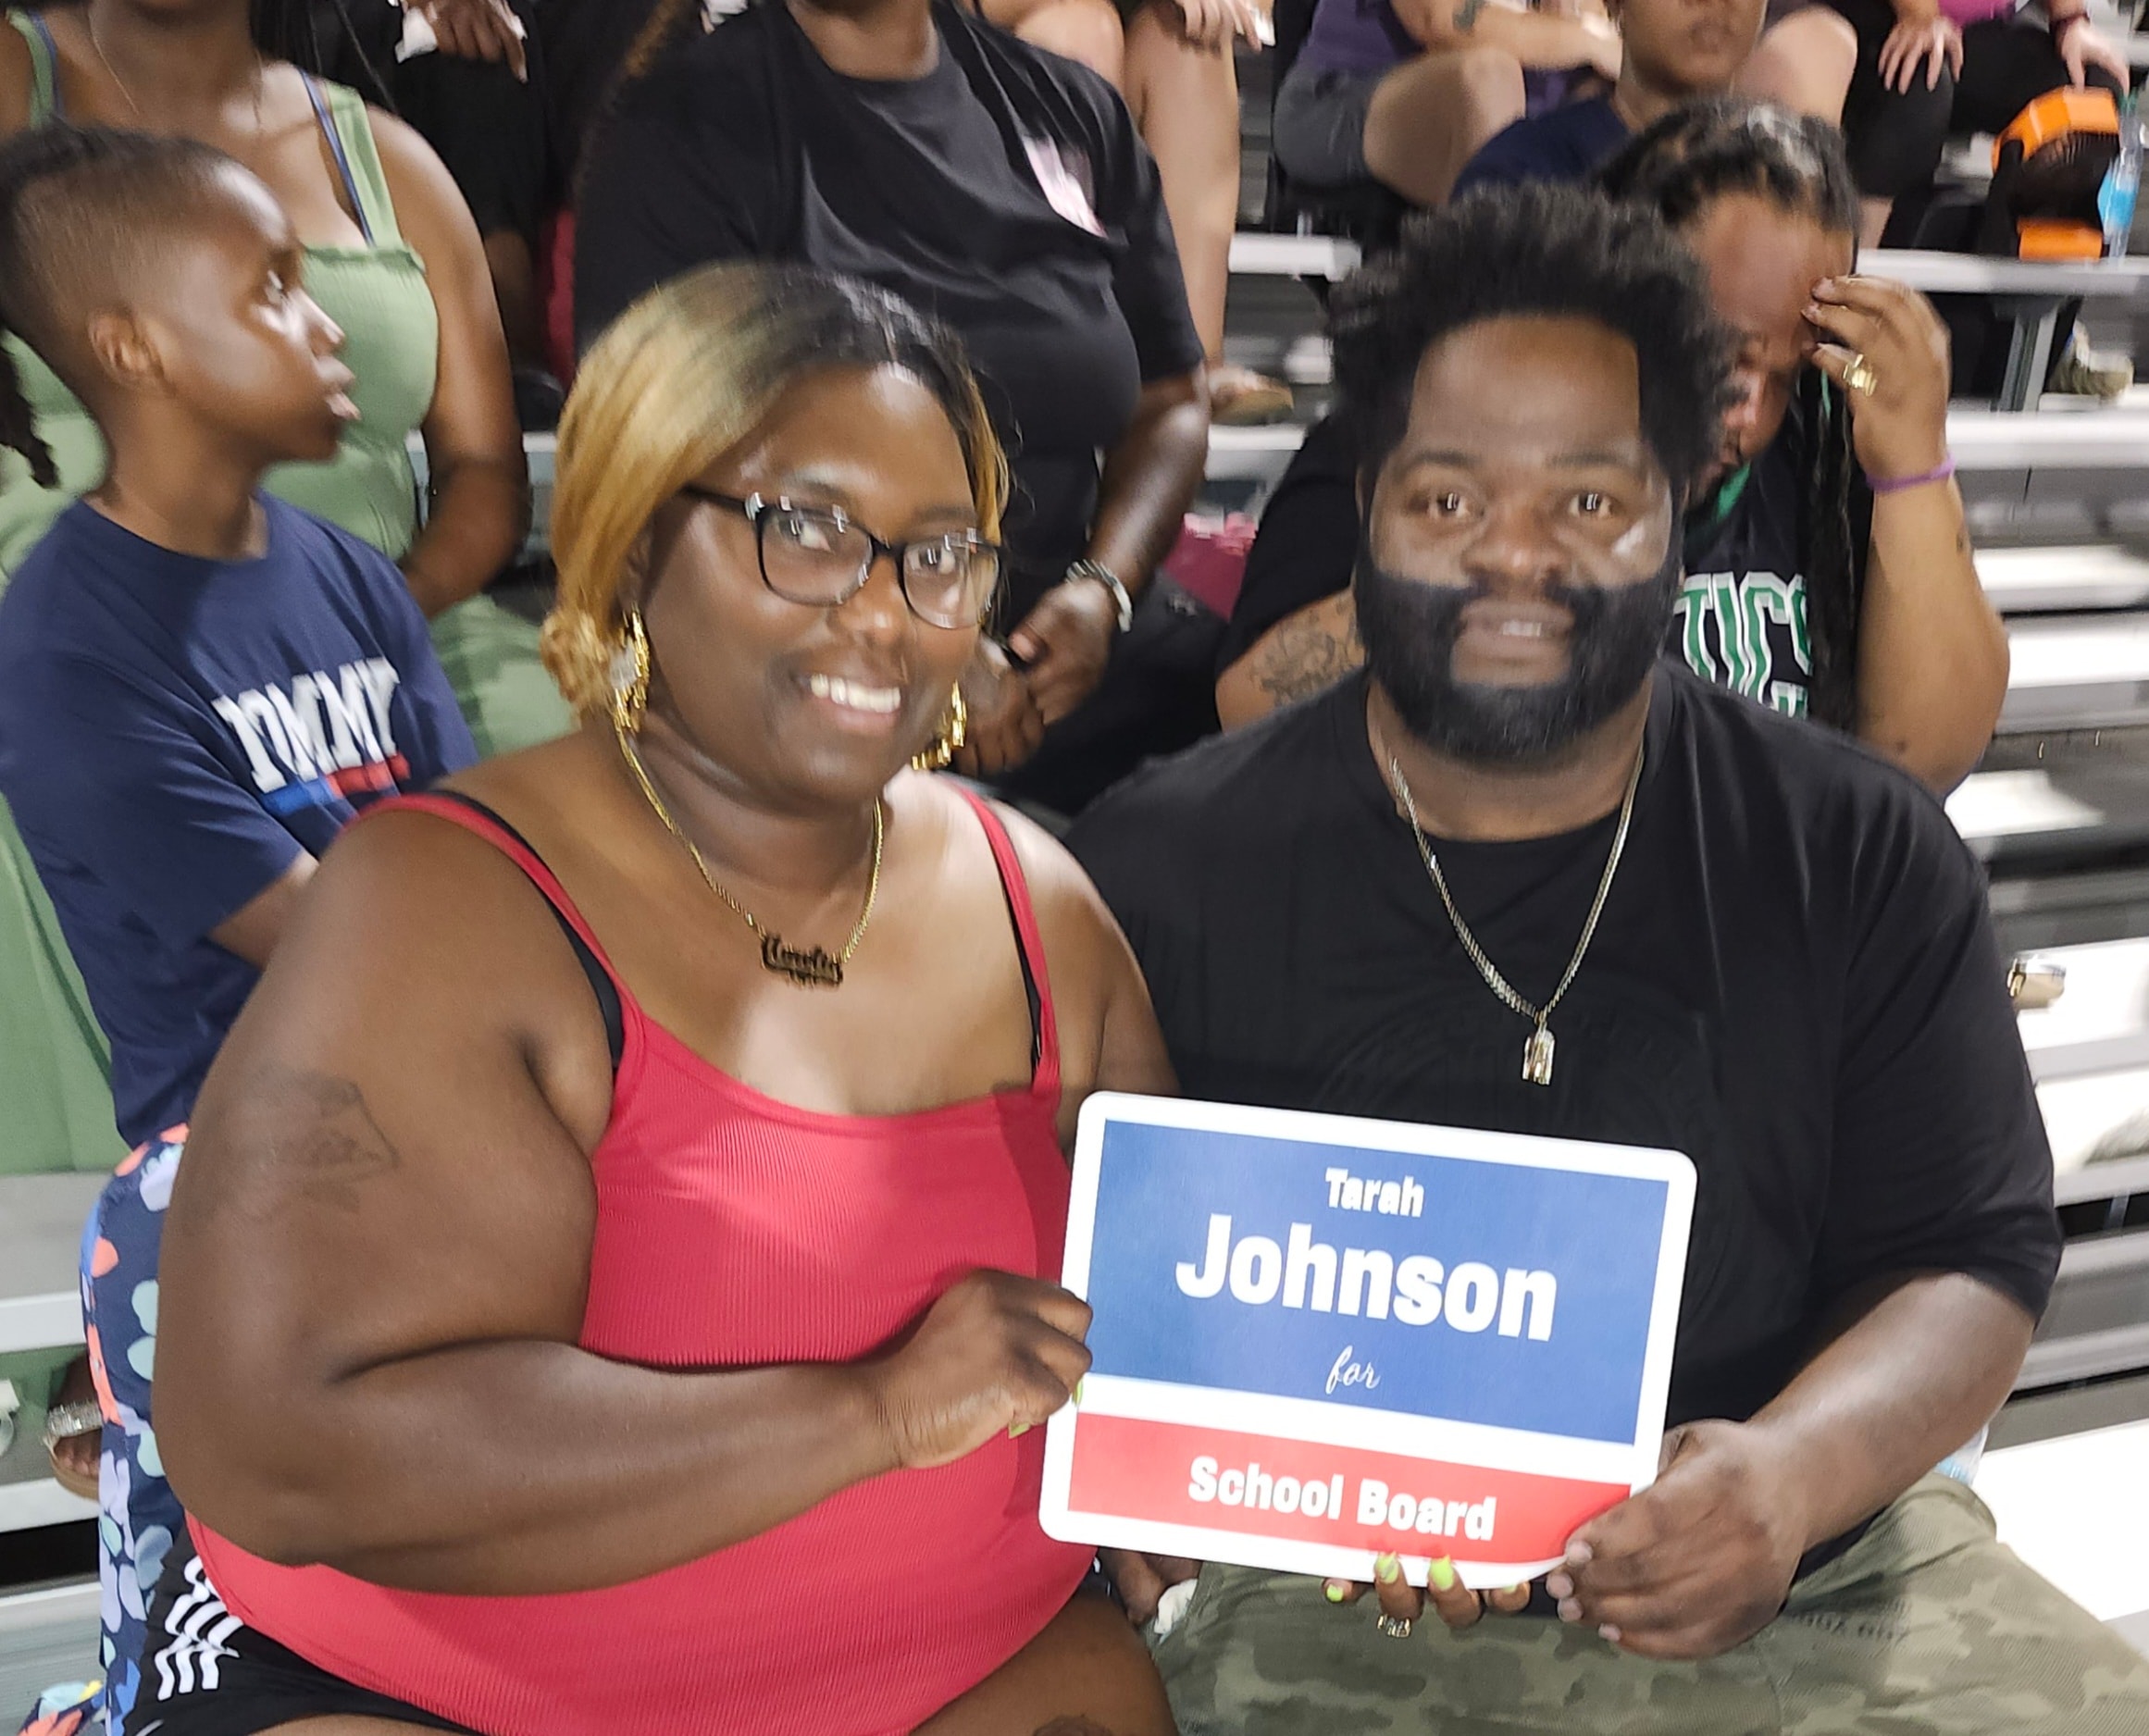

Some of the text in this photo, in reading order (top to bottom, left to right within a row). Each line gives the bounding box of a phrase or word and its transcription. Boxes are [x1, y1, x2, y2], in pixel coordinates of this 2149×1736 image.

[1324, 1167, 1425, 1218] Tarah
[1174, 1212, 1559, 1342] Johnson
[1324, 1345, 1381, 1395] for
[1187, 1455, 1497, 1542] School Board
